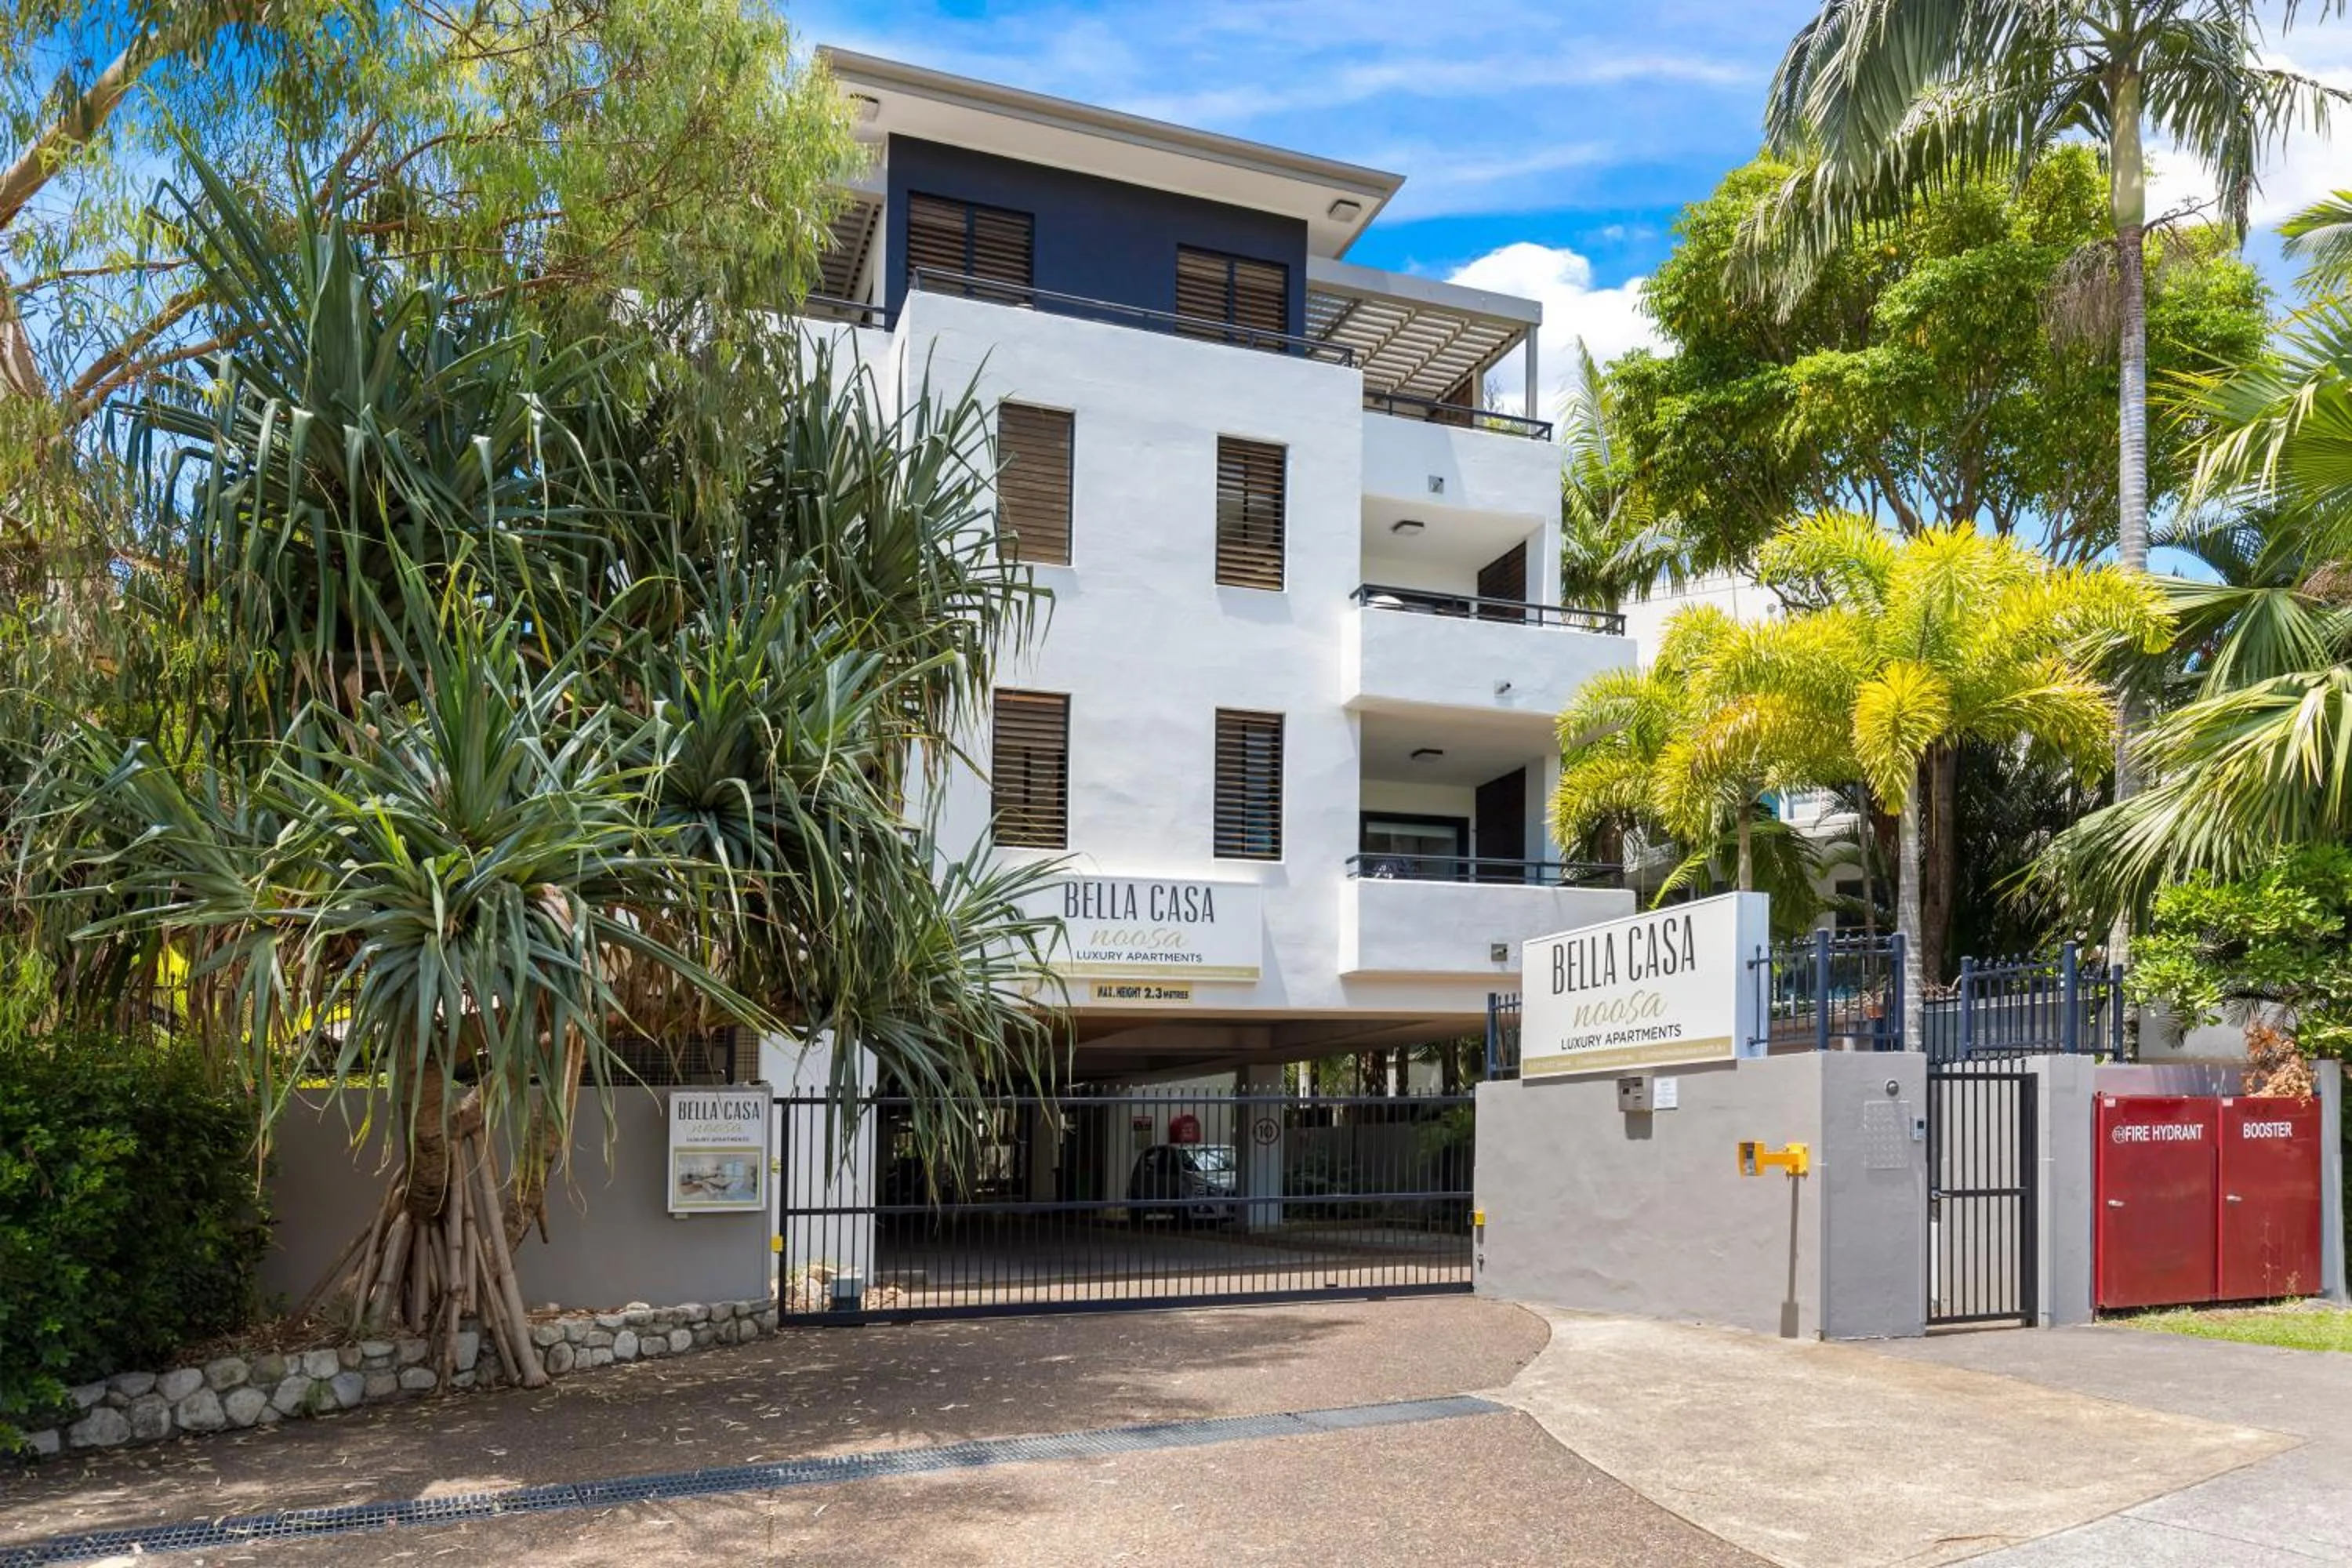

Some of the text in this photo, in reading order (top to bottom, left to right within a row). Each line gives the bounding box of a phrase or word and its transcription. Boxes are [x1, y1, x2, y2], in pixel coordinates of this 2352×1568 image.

[1065, 881, 1215, 924] BELLA CASA
[1090, 927, 1184, 949] noosa
[1076, 950, 1203, 964] LUXURY APARTMENTS
[1552, 914, 1696, 995] BELLA CASA
[1144, 986, 1163, 999] 2.3
[1573, 989, 1668, 1029] noosa
[1560, 1023, 1682, 1051] LUXURY APARTMENTS
[678, 1102, 760, 1120] BELLA CASA
[2125, 1125, 2151, 1142] FIRE
[2152, 1123, 2204, 1141] HYDRANT
[2243, 1122, 2292, 1138] BOOSTER
